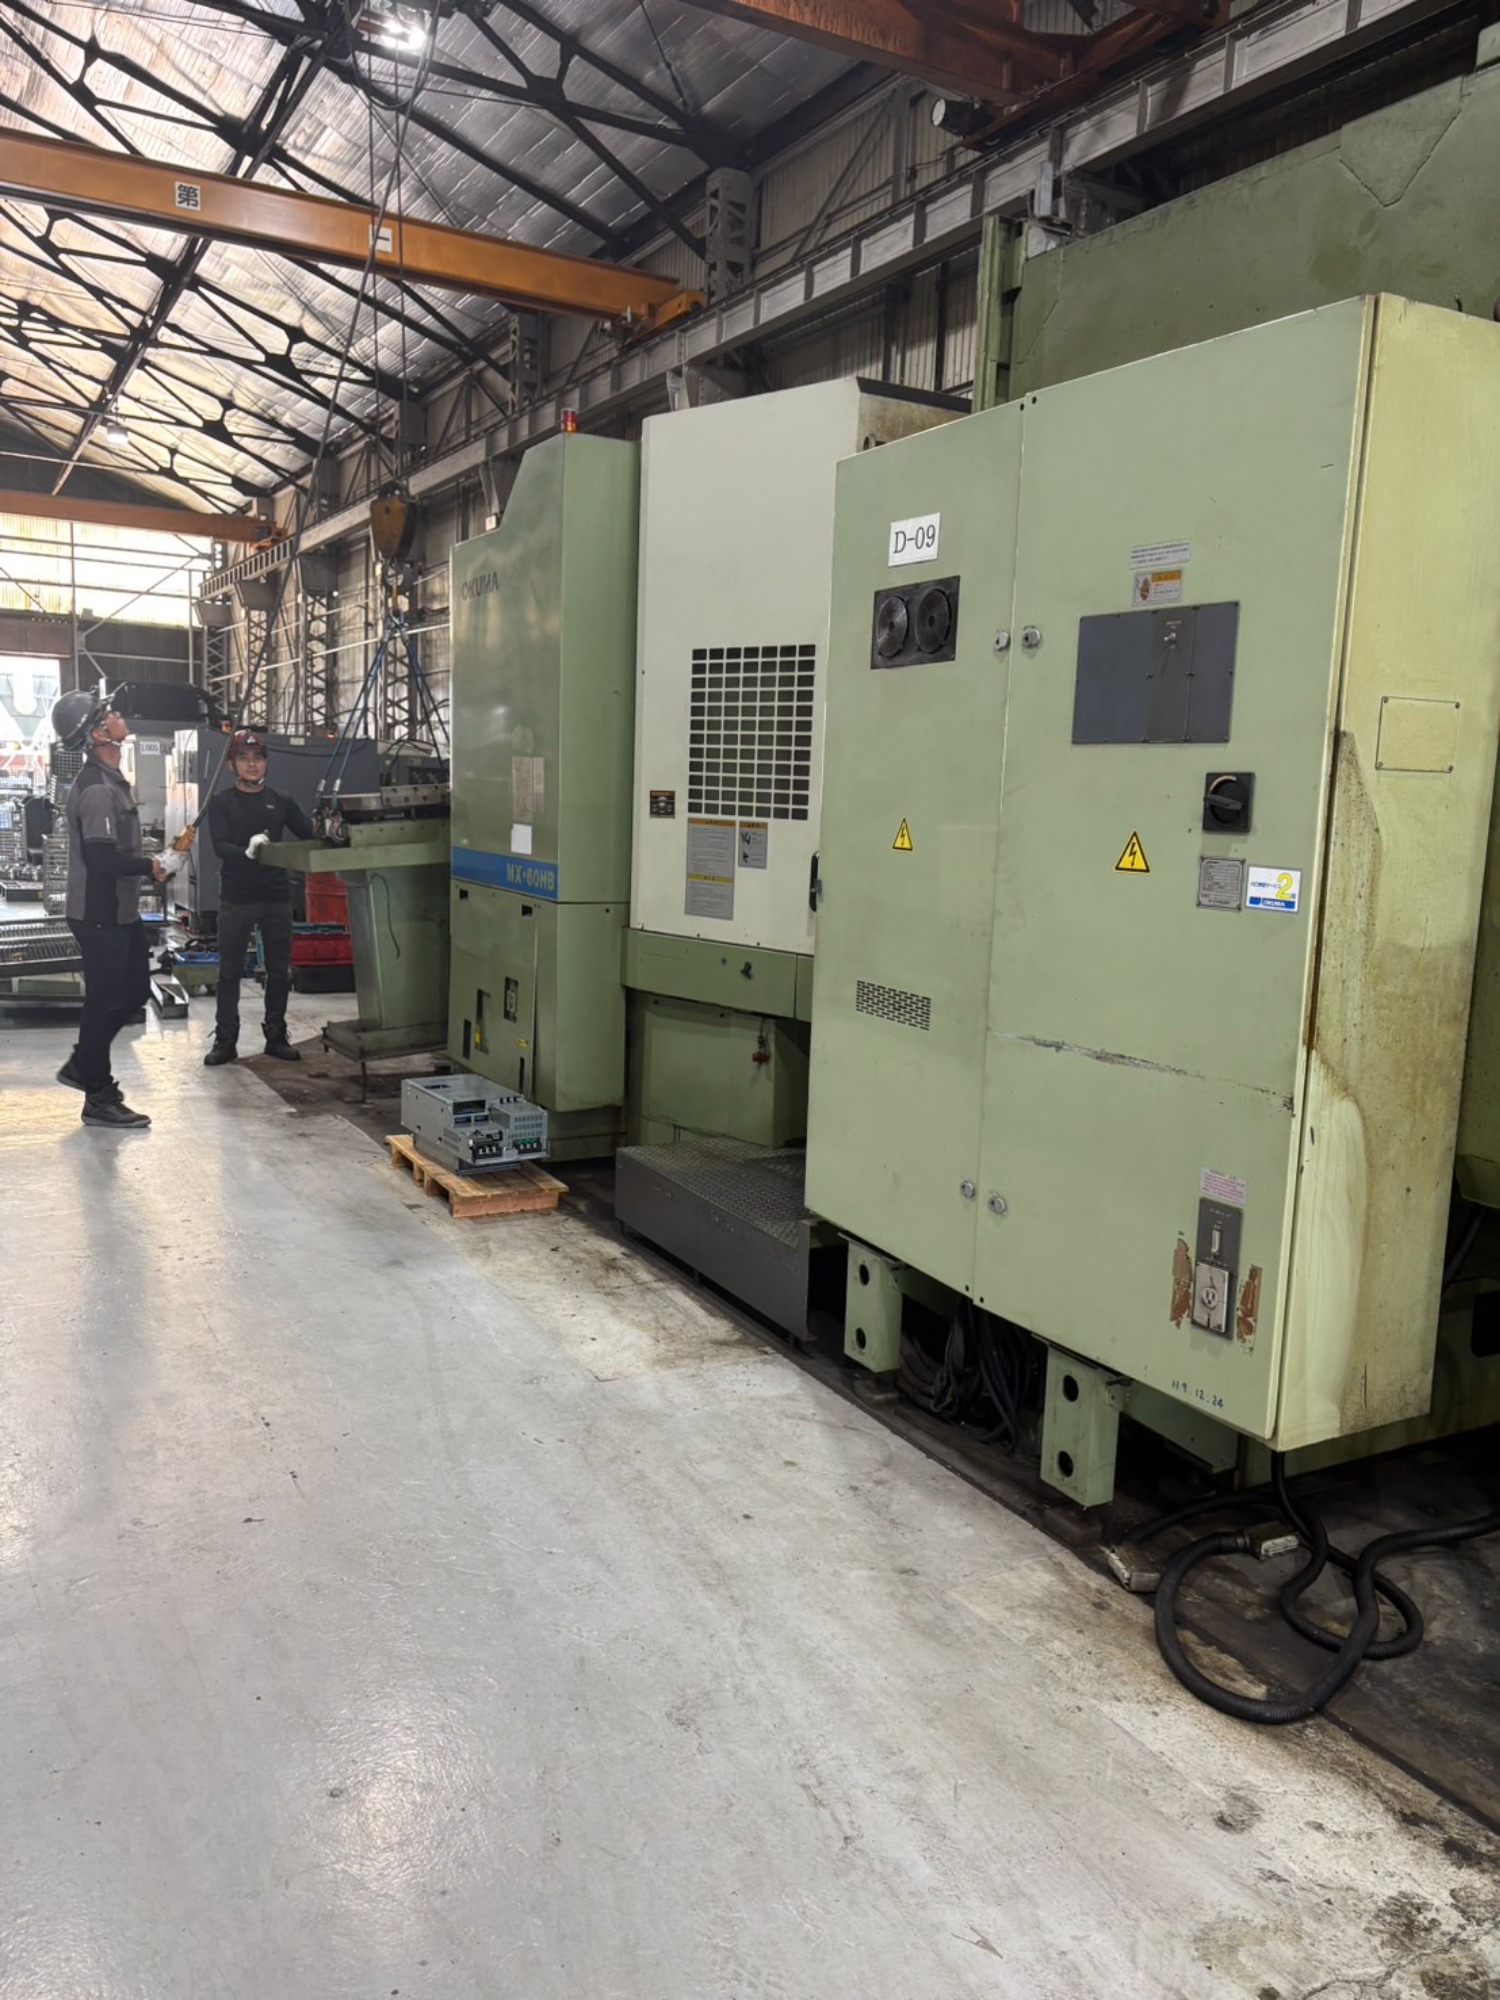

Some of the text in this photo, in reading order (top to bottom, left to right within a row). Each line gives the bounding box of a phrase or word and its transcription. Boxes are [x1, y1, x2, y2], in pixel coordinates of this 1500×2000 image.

[178, 183, 199, 208] 第
[893, 524, 936, 554] D-09
[461, 570, 499, 600] OKUMA
